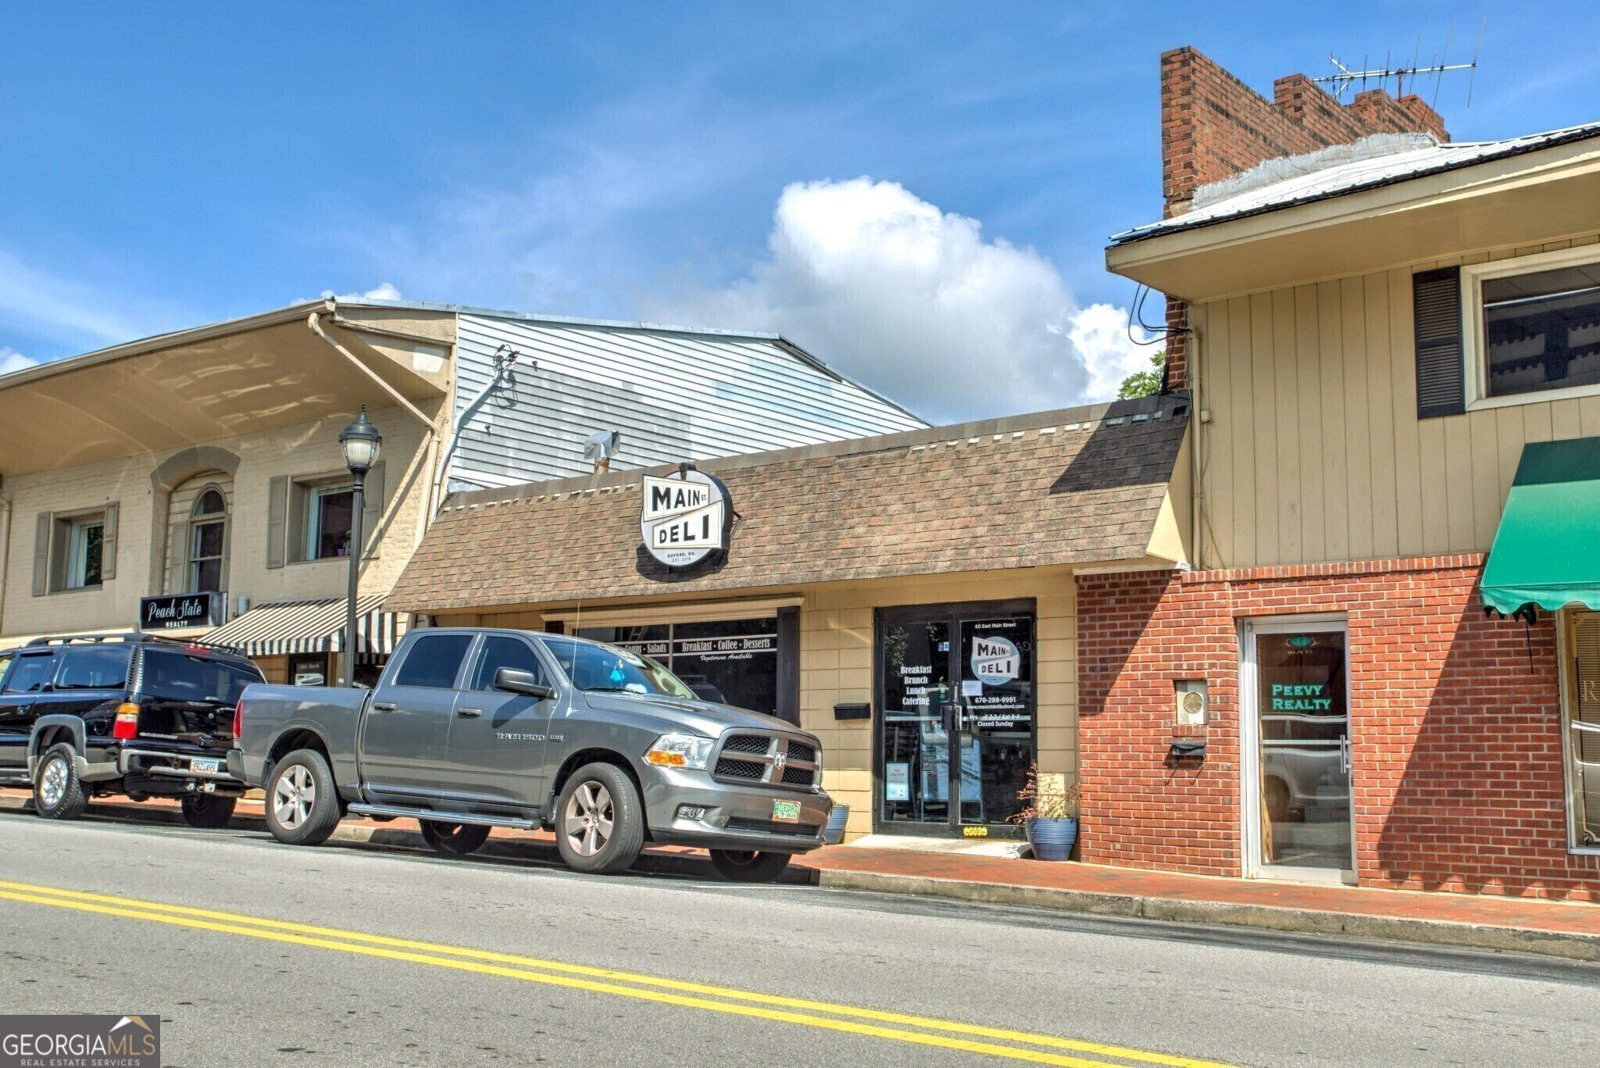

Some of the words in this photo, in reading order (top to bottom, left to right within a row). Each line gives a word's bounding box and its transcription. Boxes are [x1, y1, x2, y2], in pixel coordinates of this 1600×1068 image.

[652, 486, 700, 511] MAIN
[660, 514, 709, 544] DELI
[148, 598, 176, 622] Peach
[176, 598, 202, 620] State
[165, 620, 188, 628] REALTY
[647, 643, 667, 653] Salads
[682, 641, 712, 652] Breakfast
[718, 640, 738, 650] Coffee
[743, 638, 771, 649] Desserts
[977, 642, 1006, 656] MAIN
[900, 665, 932, 674] Breakfast
[981, 660, 1011, 673] DELI
[904, 676, 928, 684] Brunch
[906, 686, 926, 695] Lunch
[1272, 684, 1323, 696] PEEVY
[902, 697, 930, 706] Catering
[1272, 698, 1332, 710] REALTY
[995, 720, 1014, 728] Sunday
